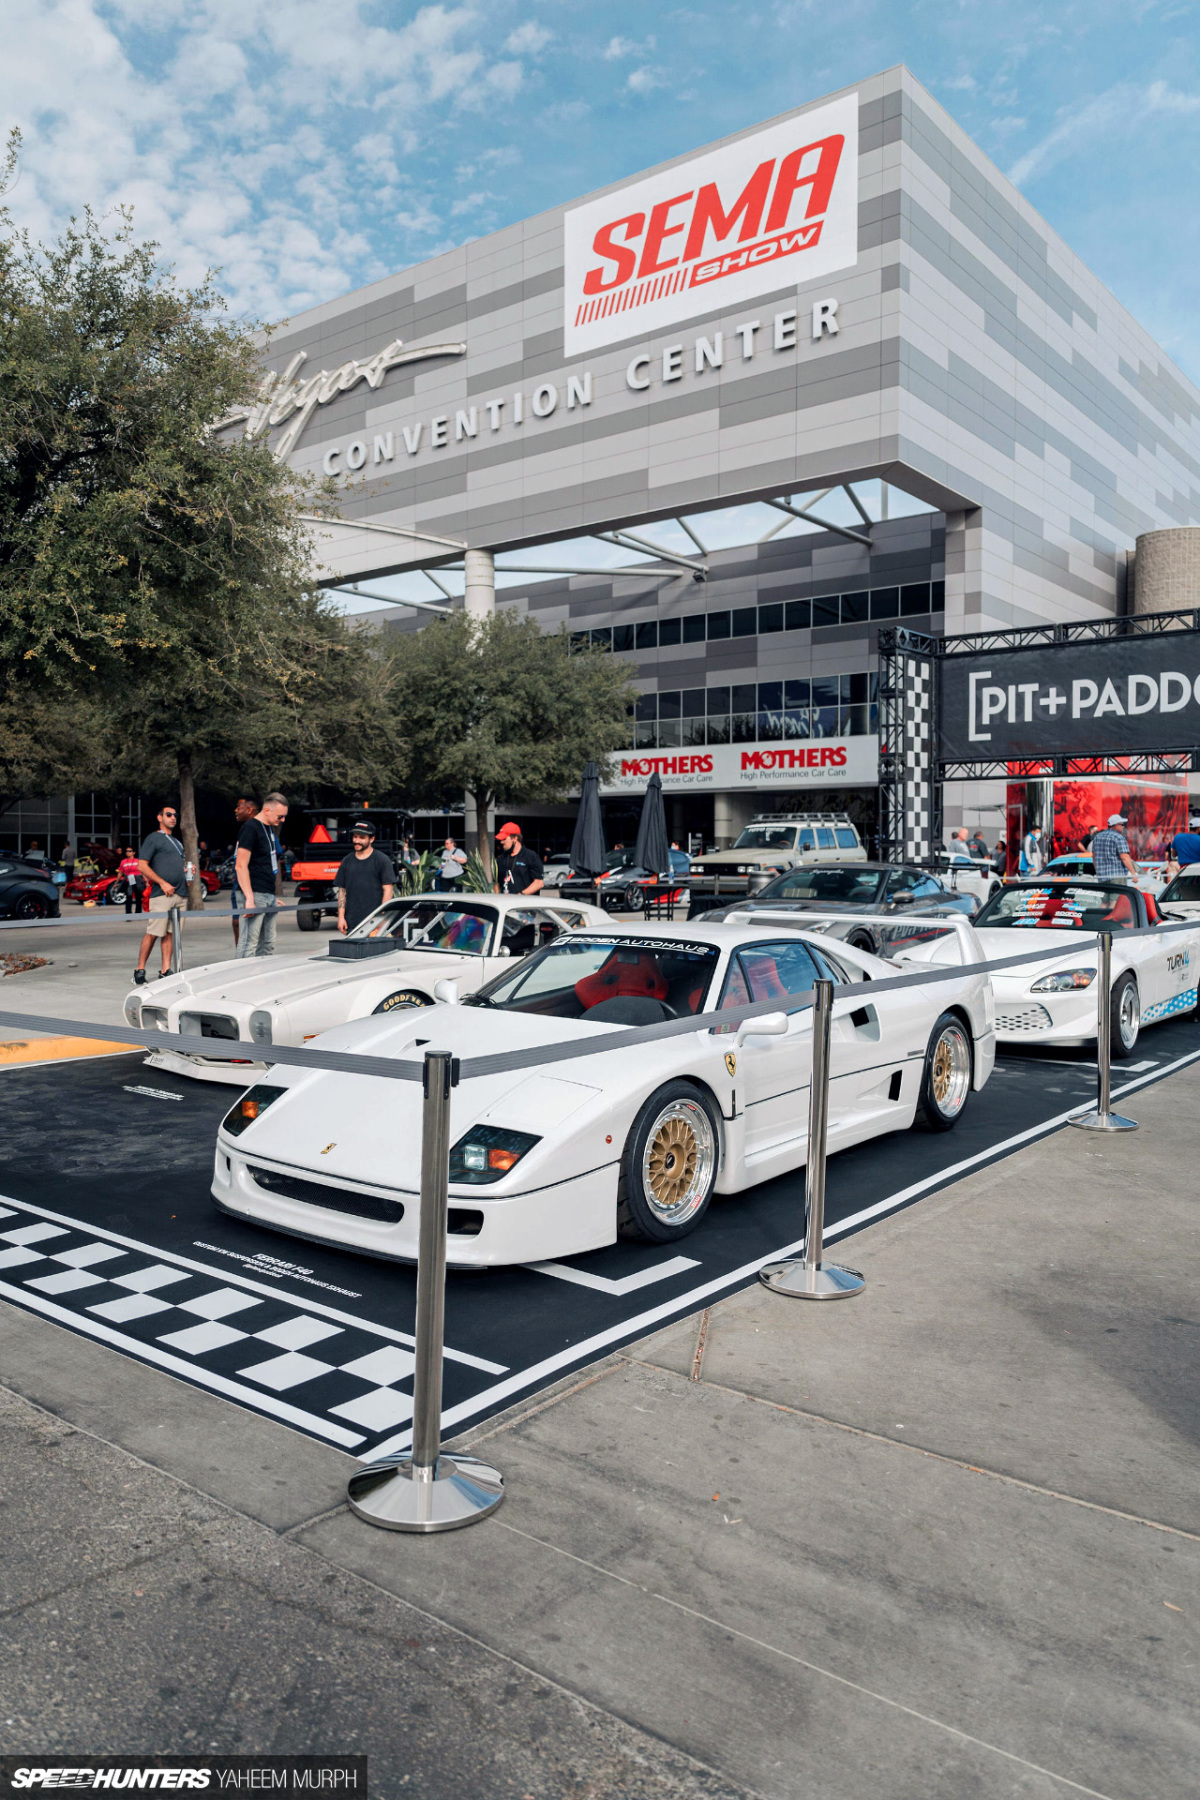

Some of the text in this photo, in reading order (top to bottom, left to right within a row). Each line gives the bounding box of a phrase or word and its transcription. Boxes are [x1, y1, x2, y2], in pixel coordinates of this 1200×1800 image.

[582, 133, 845, 296] SEMA
[695, 226, 818, 281] SHOW
[321, 298, 840, 477] CONVENTION CENTER
[621, 754, 713, 776] MOTHERS
[741, 746, 847, 770] MOTHERS
[621, 776, 637, 786] High
[683, 774, 695, 782] Car
[696, 774, 713, 782] Care
[740, 768, 847, 780] High Performance Car Care
[619, 938, 710, 954] AUTOHAUS
